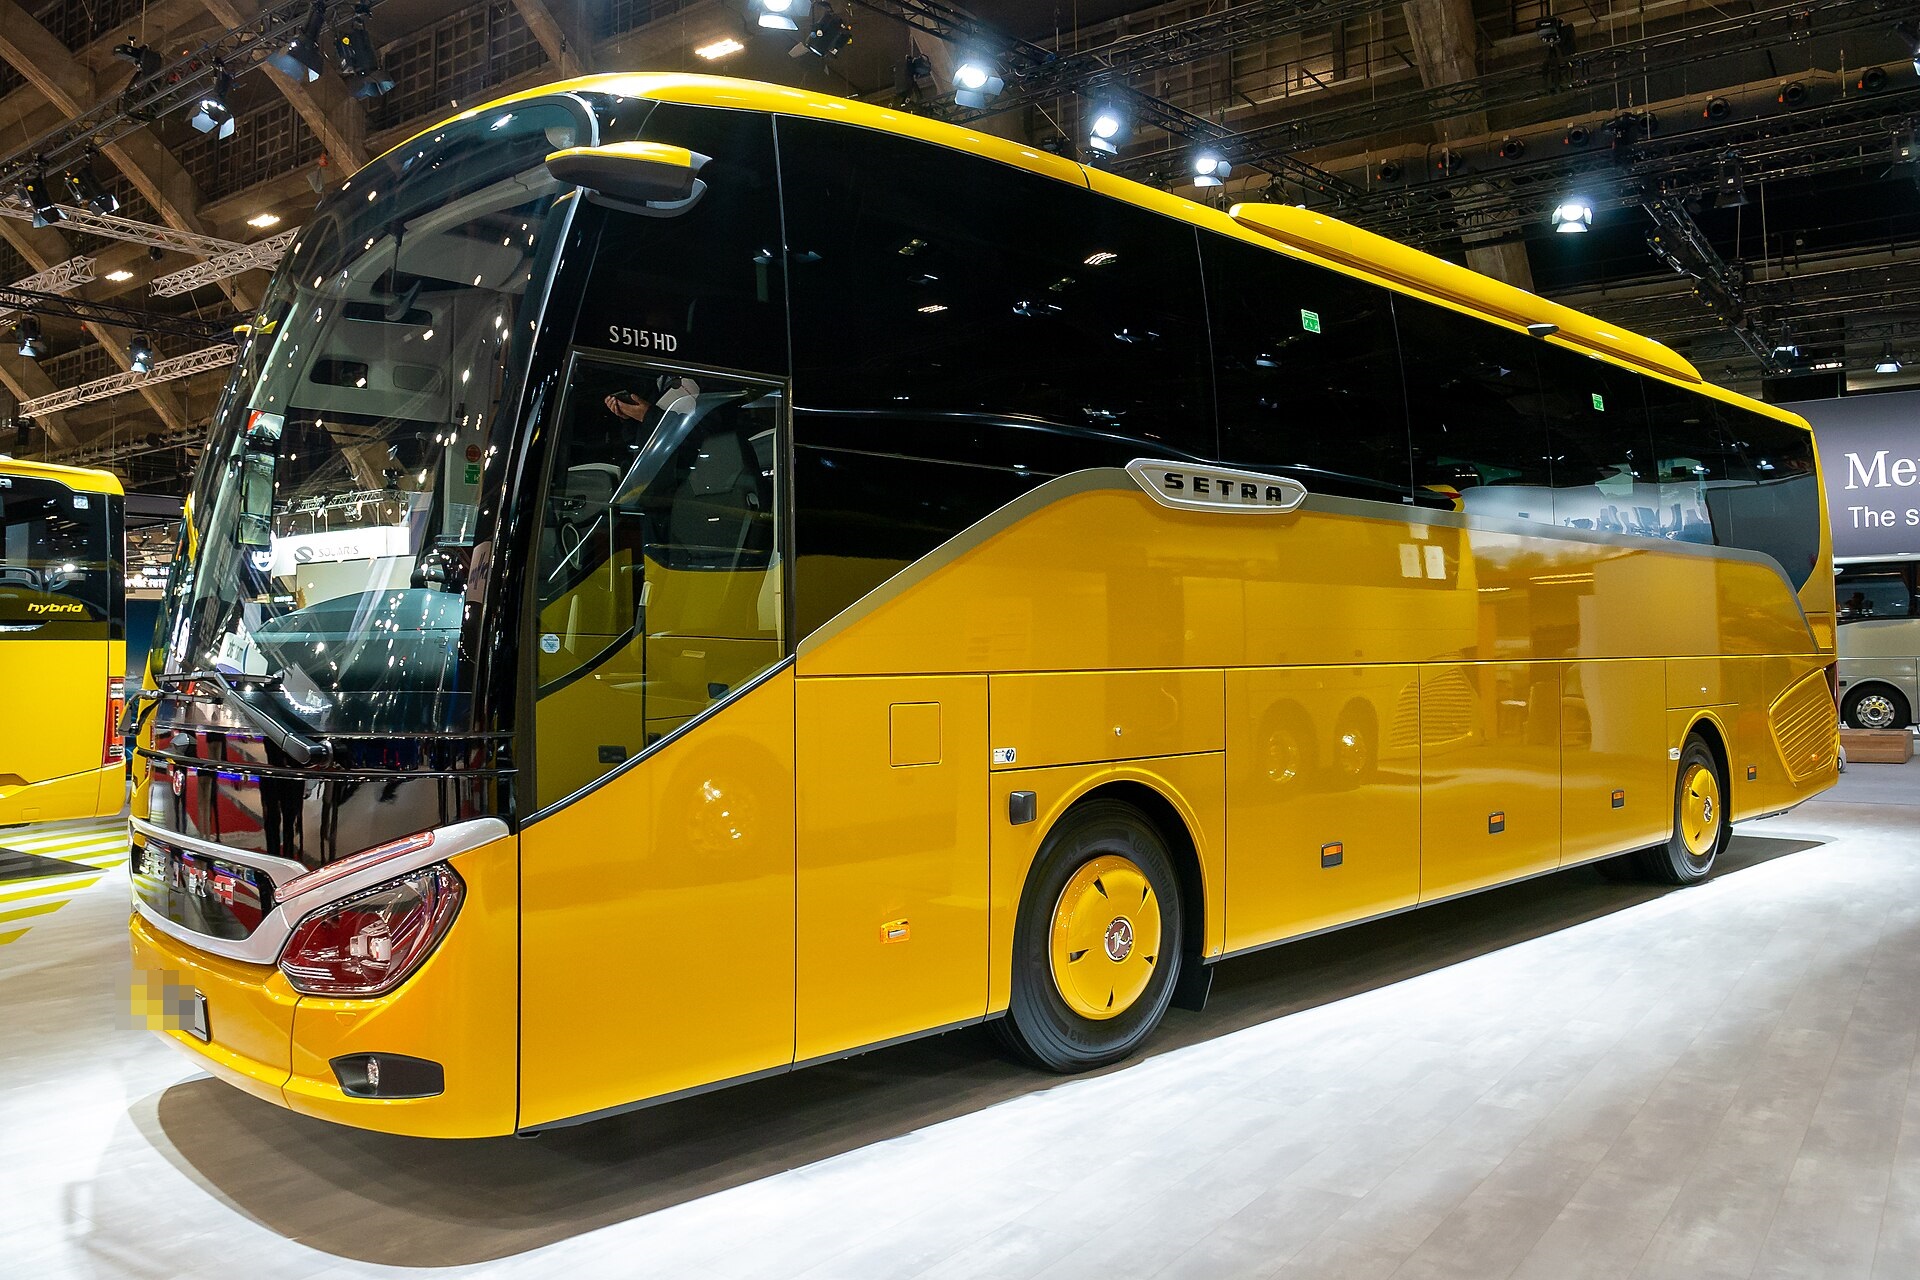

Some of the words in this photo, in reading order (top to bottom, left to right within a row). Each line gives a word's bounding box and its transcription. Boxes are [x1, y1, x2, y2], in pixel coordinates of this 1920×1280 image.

[609, 325, 620, 343] S
[622, 327, 650, 347] 515
[652, 332, 677, 352] HD
[1844, 450, 1920, 490] Me
[1163, 472, 1283, 502] SETRA
[1847, 505, 1896, 529] The
[27, 602, 84, 615] hybrid
